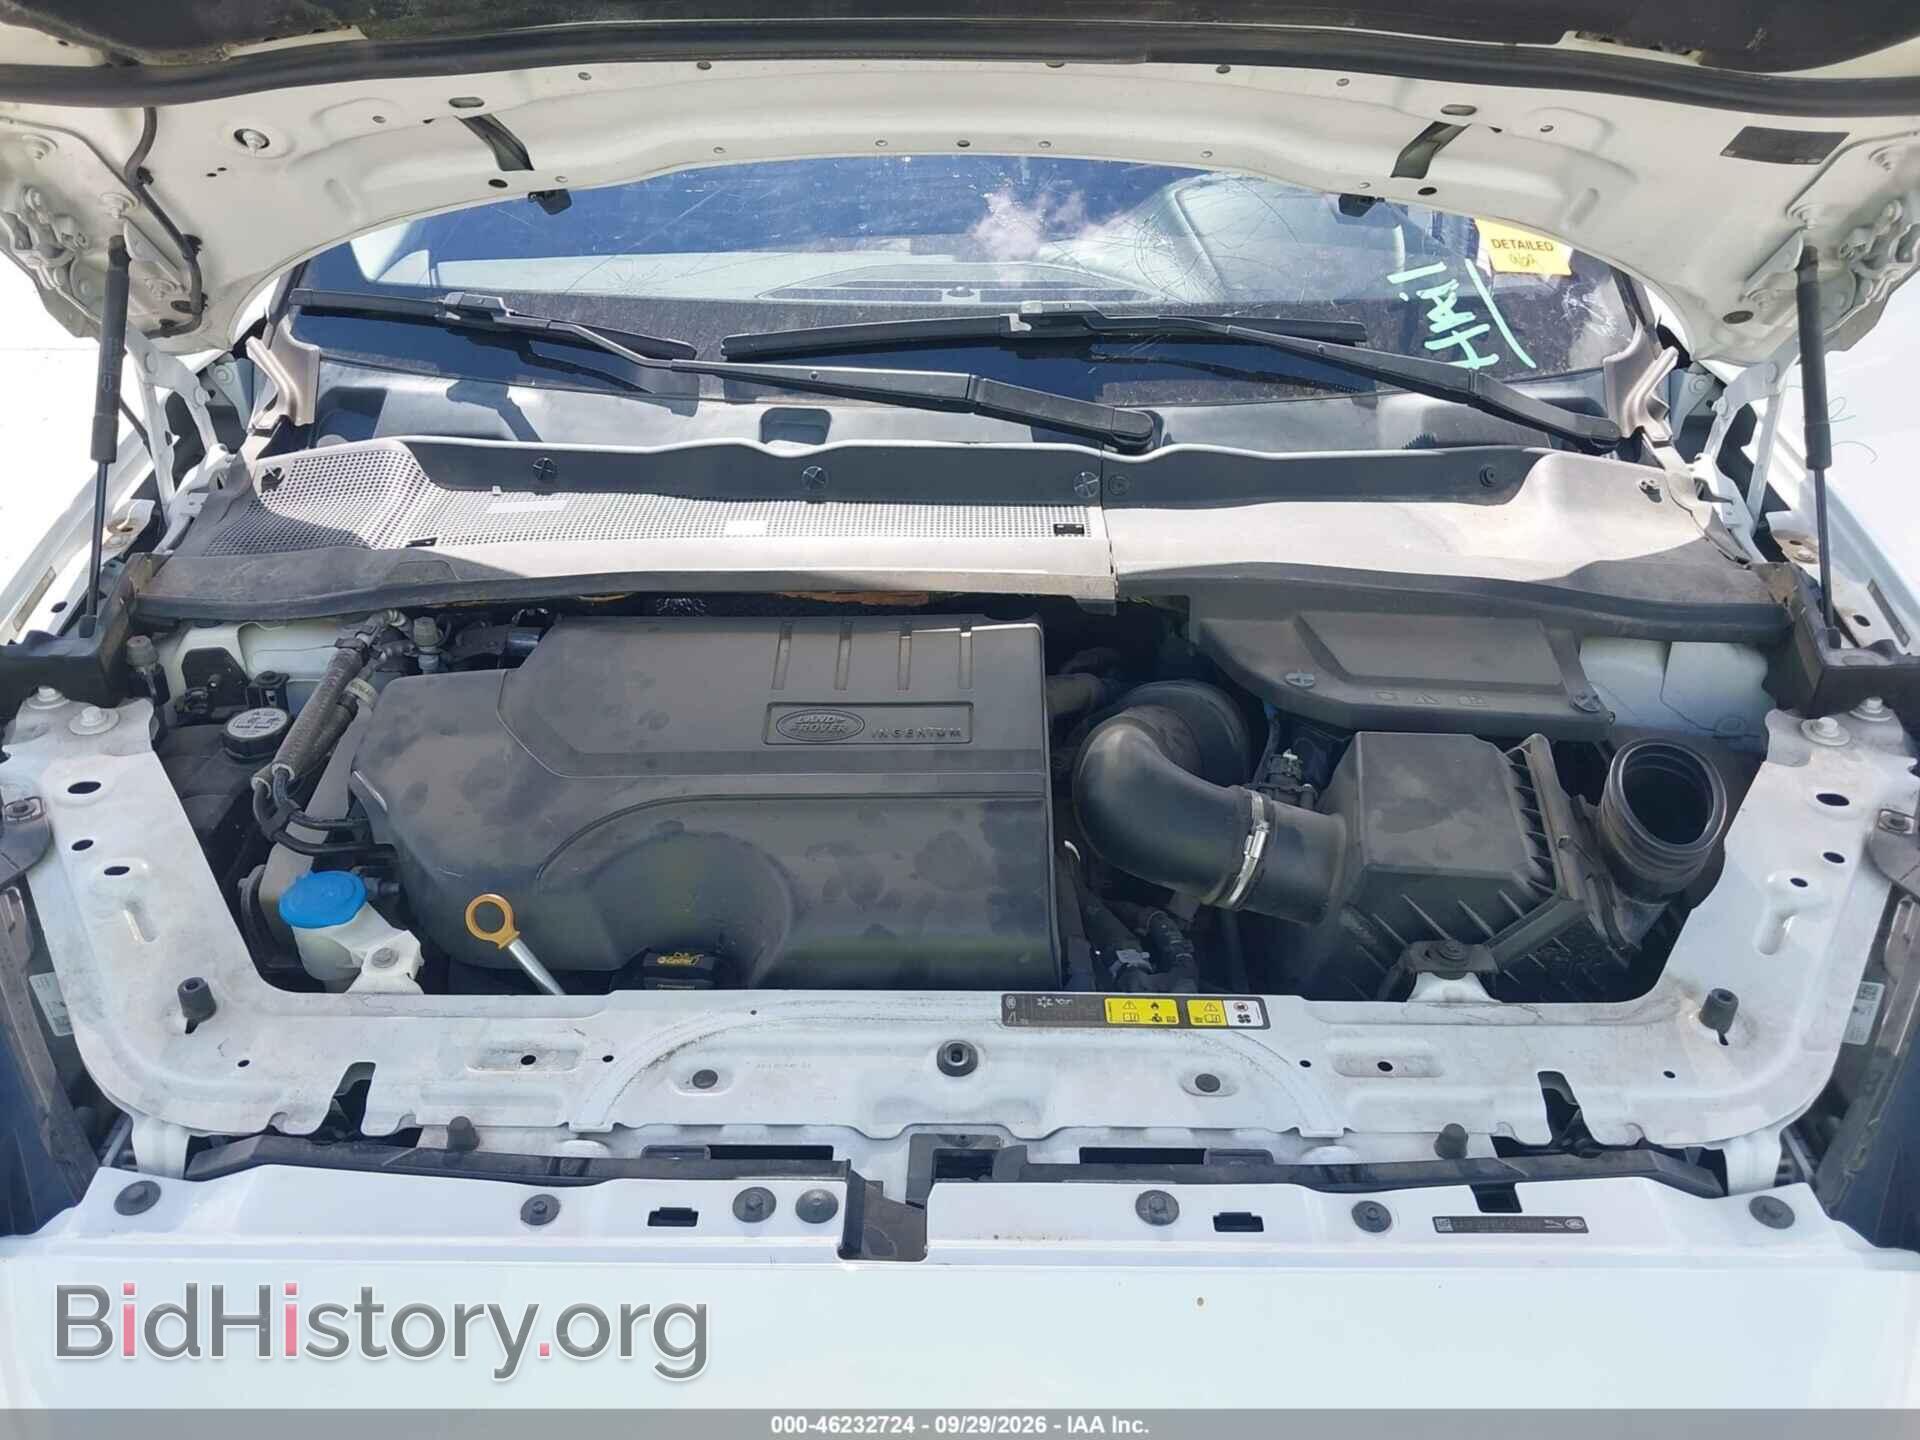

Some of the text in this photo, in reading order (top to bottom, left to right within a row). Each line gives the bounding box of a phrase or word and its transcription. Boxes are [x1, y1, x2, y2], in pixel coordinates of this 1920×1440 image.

[1490, 238, 1555, 252] DETAILED
[798, 714, 838, 724] LAND
[797, 723, 848, 733] ROVER
